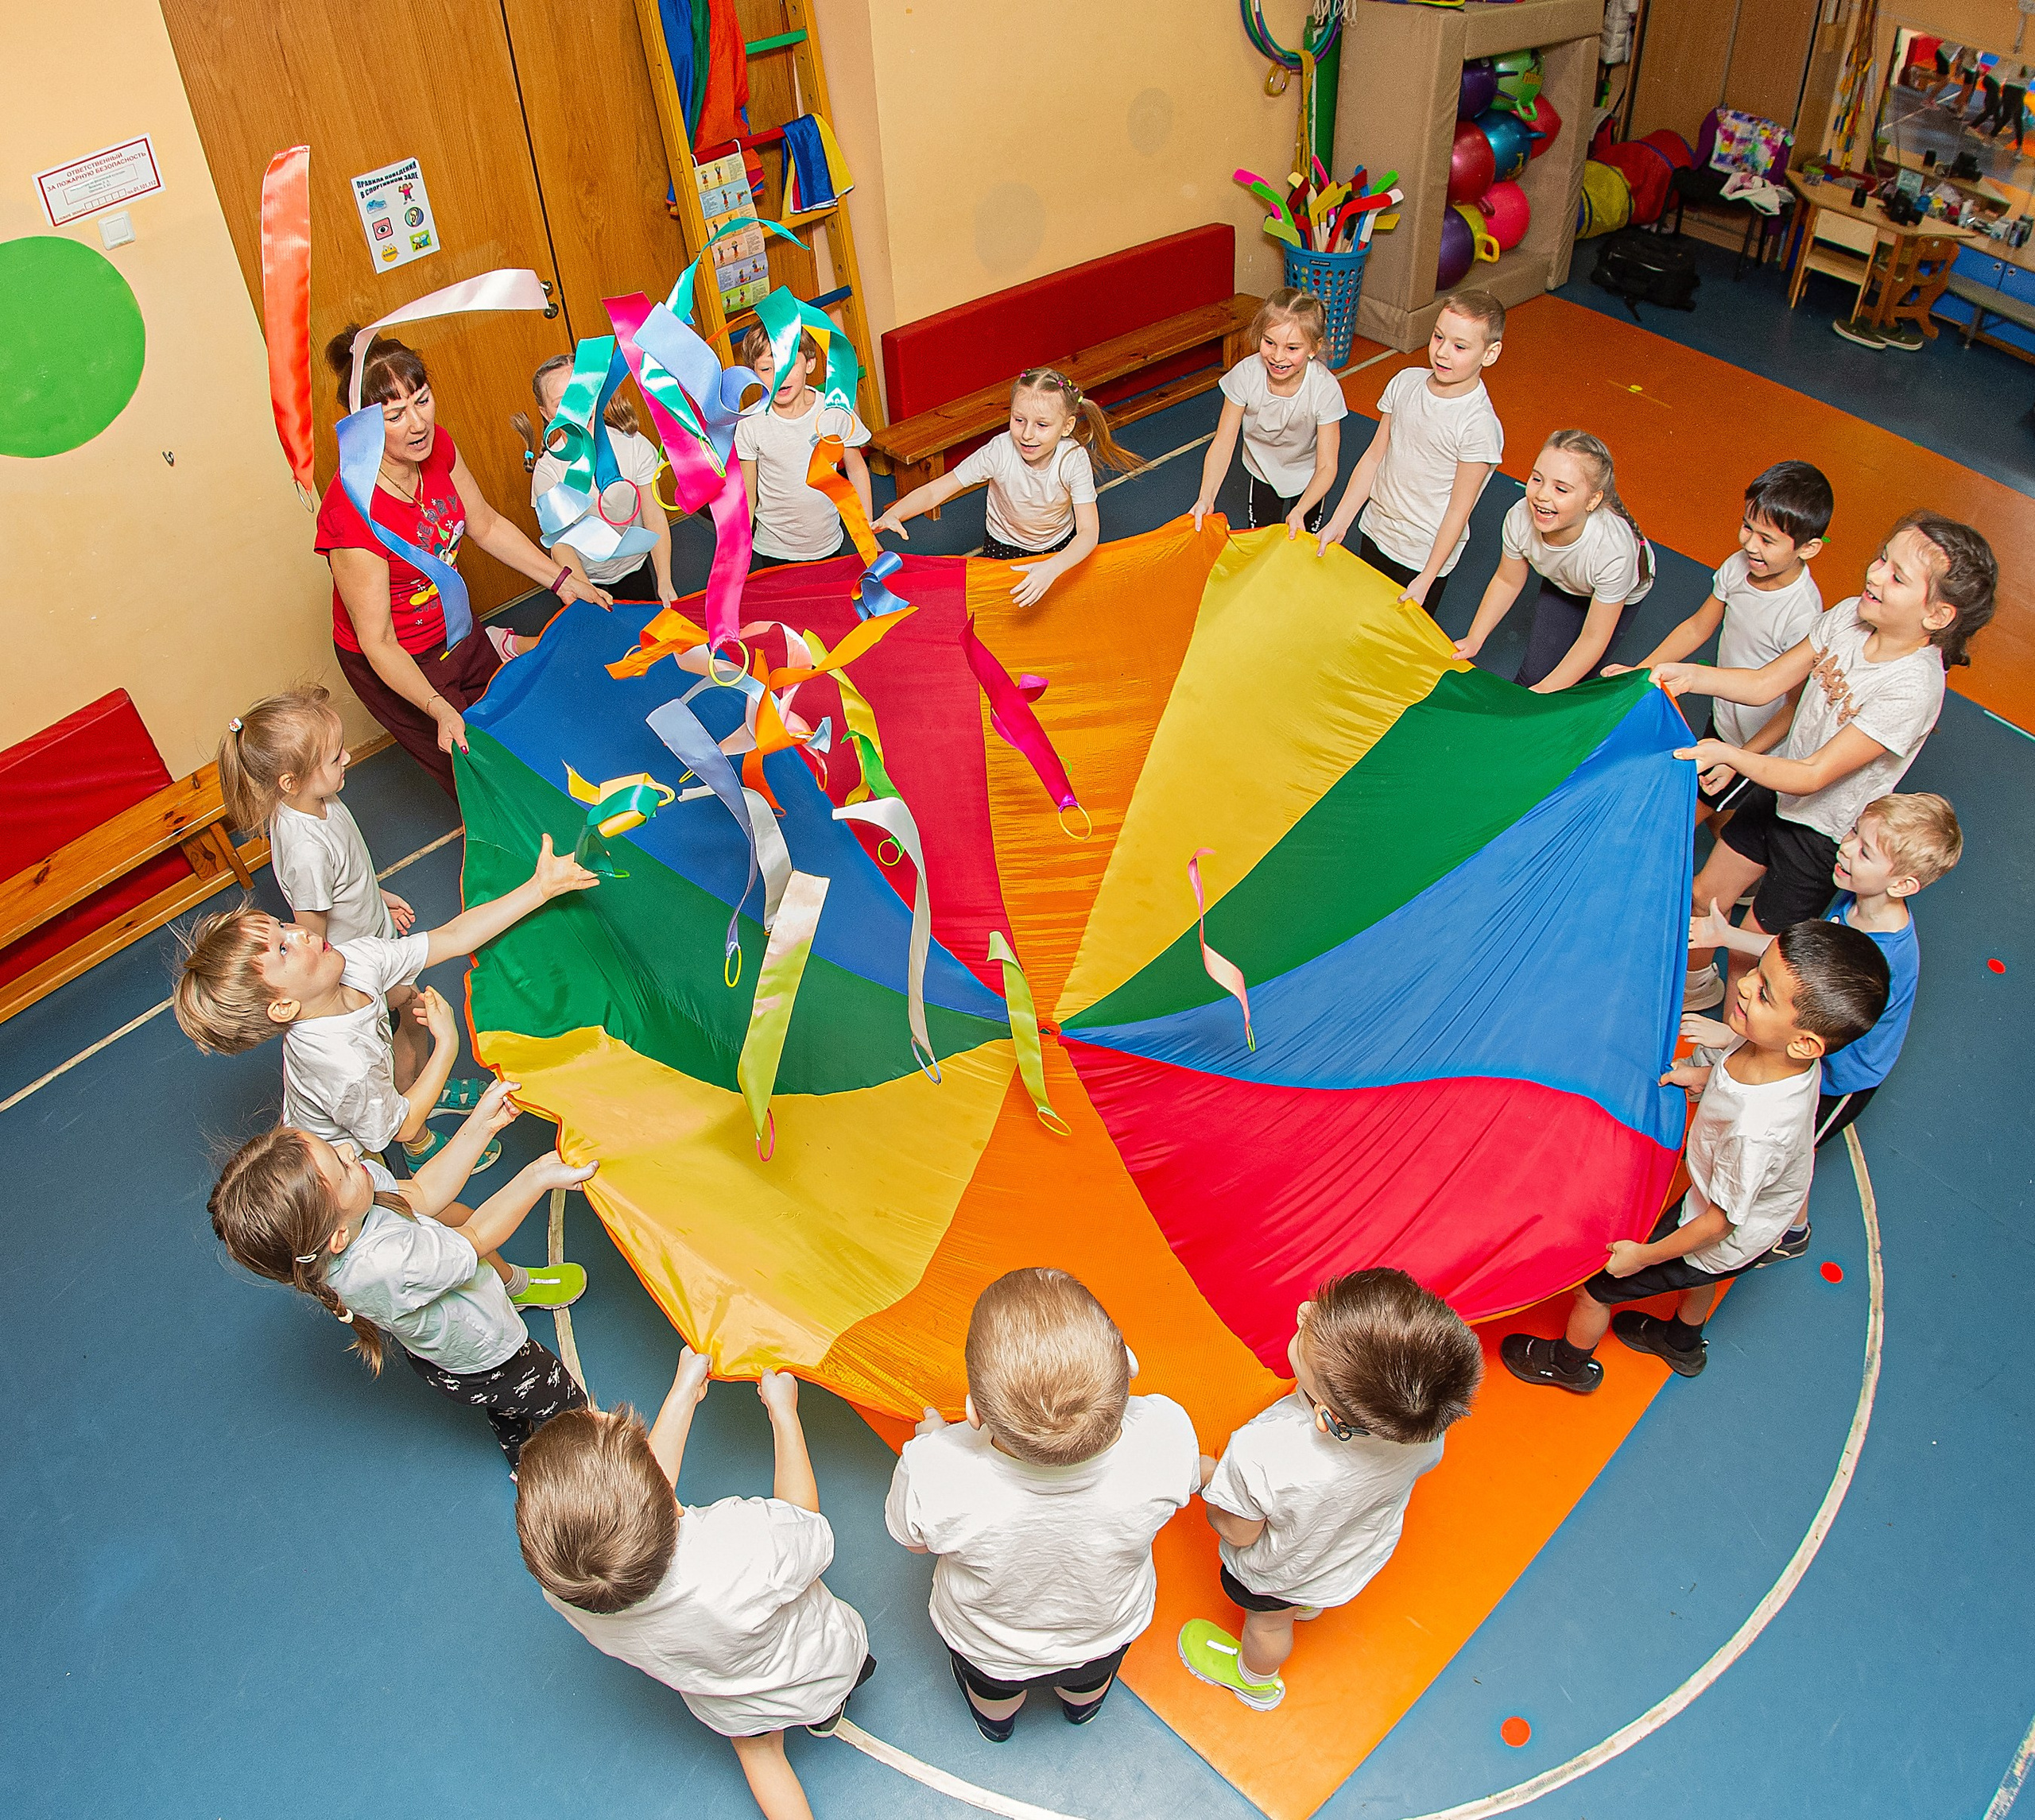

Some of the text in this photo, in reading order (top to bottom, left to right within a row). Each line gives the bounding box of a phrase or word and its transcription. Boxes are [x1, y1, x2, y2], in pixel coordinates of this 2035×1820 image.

[56, 170, 94, 188] ПОЖАРНУЮ
[95, 152, 146, 173] БЕЗОПАСНОСТЬ
[66, 152, 122, 176] ОТВЕТСТВЕННЫЙ
[356, 161, 417, 188] ПРАВИЛА ПОВЕДЕНИЯ
[365, 176, 403, 196] СПОРТИВНОМ
[416, 494, 458, 552] MERRY
